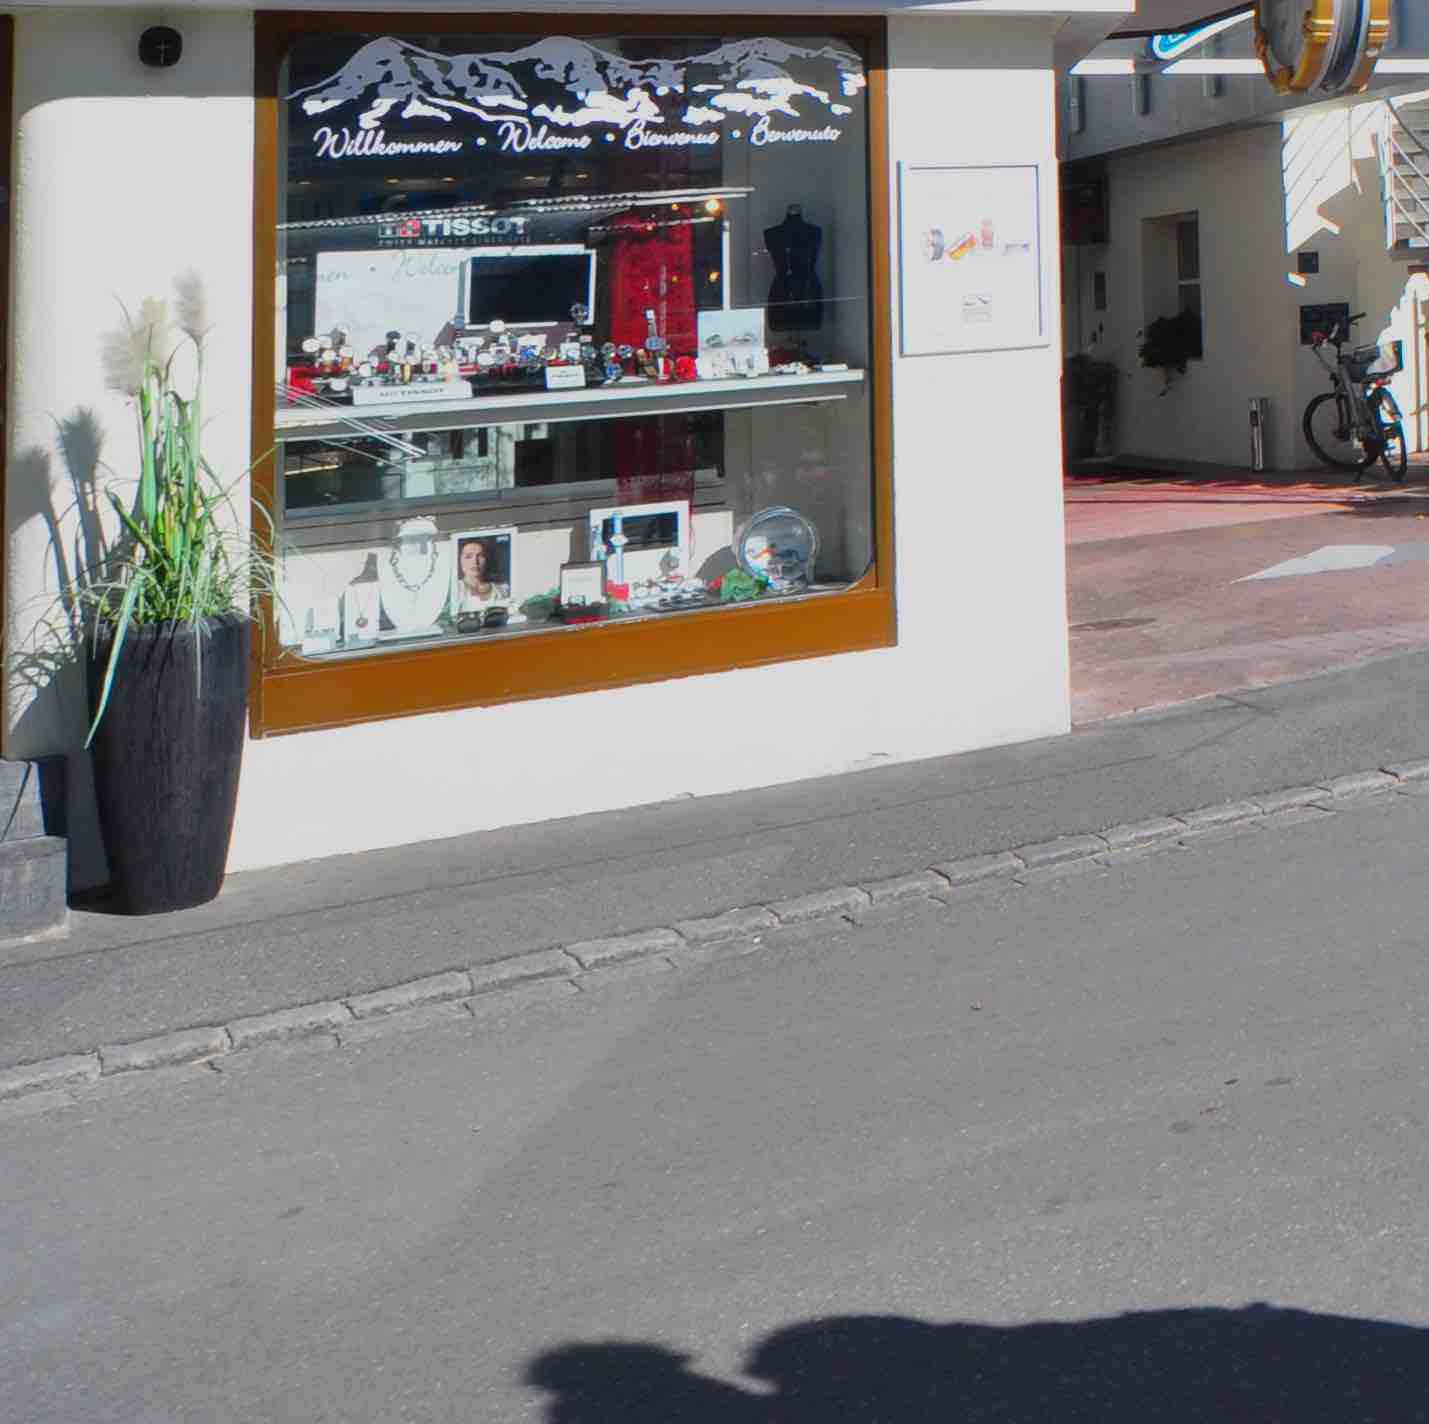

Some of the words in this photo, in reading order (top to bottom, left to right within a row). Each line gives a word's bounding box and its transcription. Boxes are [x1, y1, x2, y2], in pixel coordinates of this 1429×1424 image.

[313, 126, 462, 159] Willkommen
[498, 121, 592, 153] Welcome
[624, 119, 720, 149] Bienvenue
[750, 115, 842, 145] Benvenuto
[422, 217, 529, 237] TISSOT
